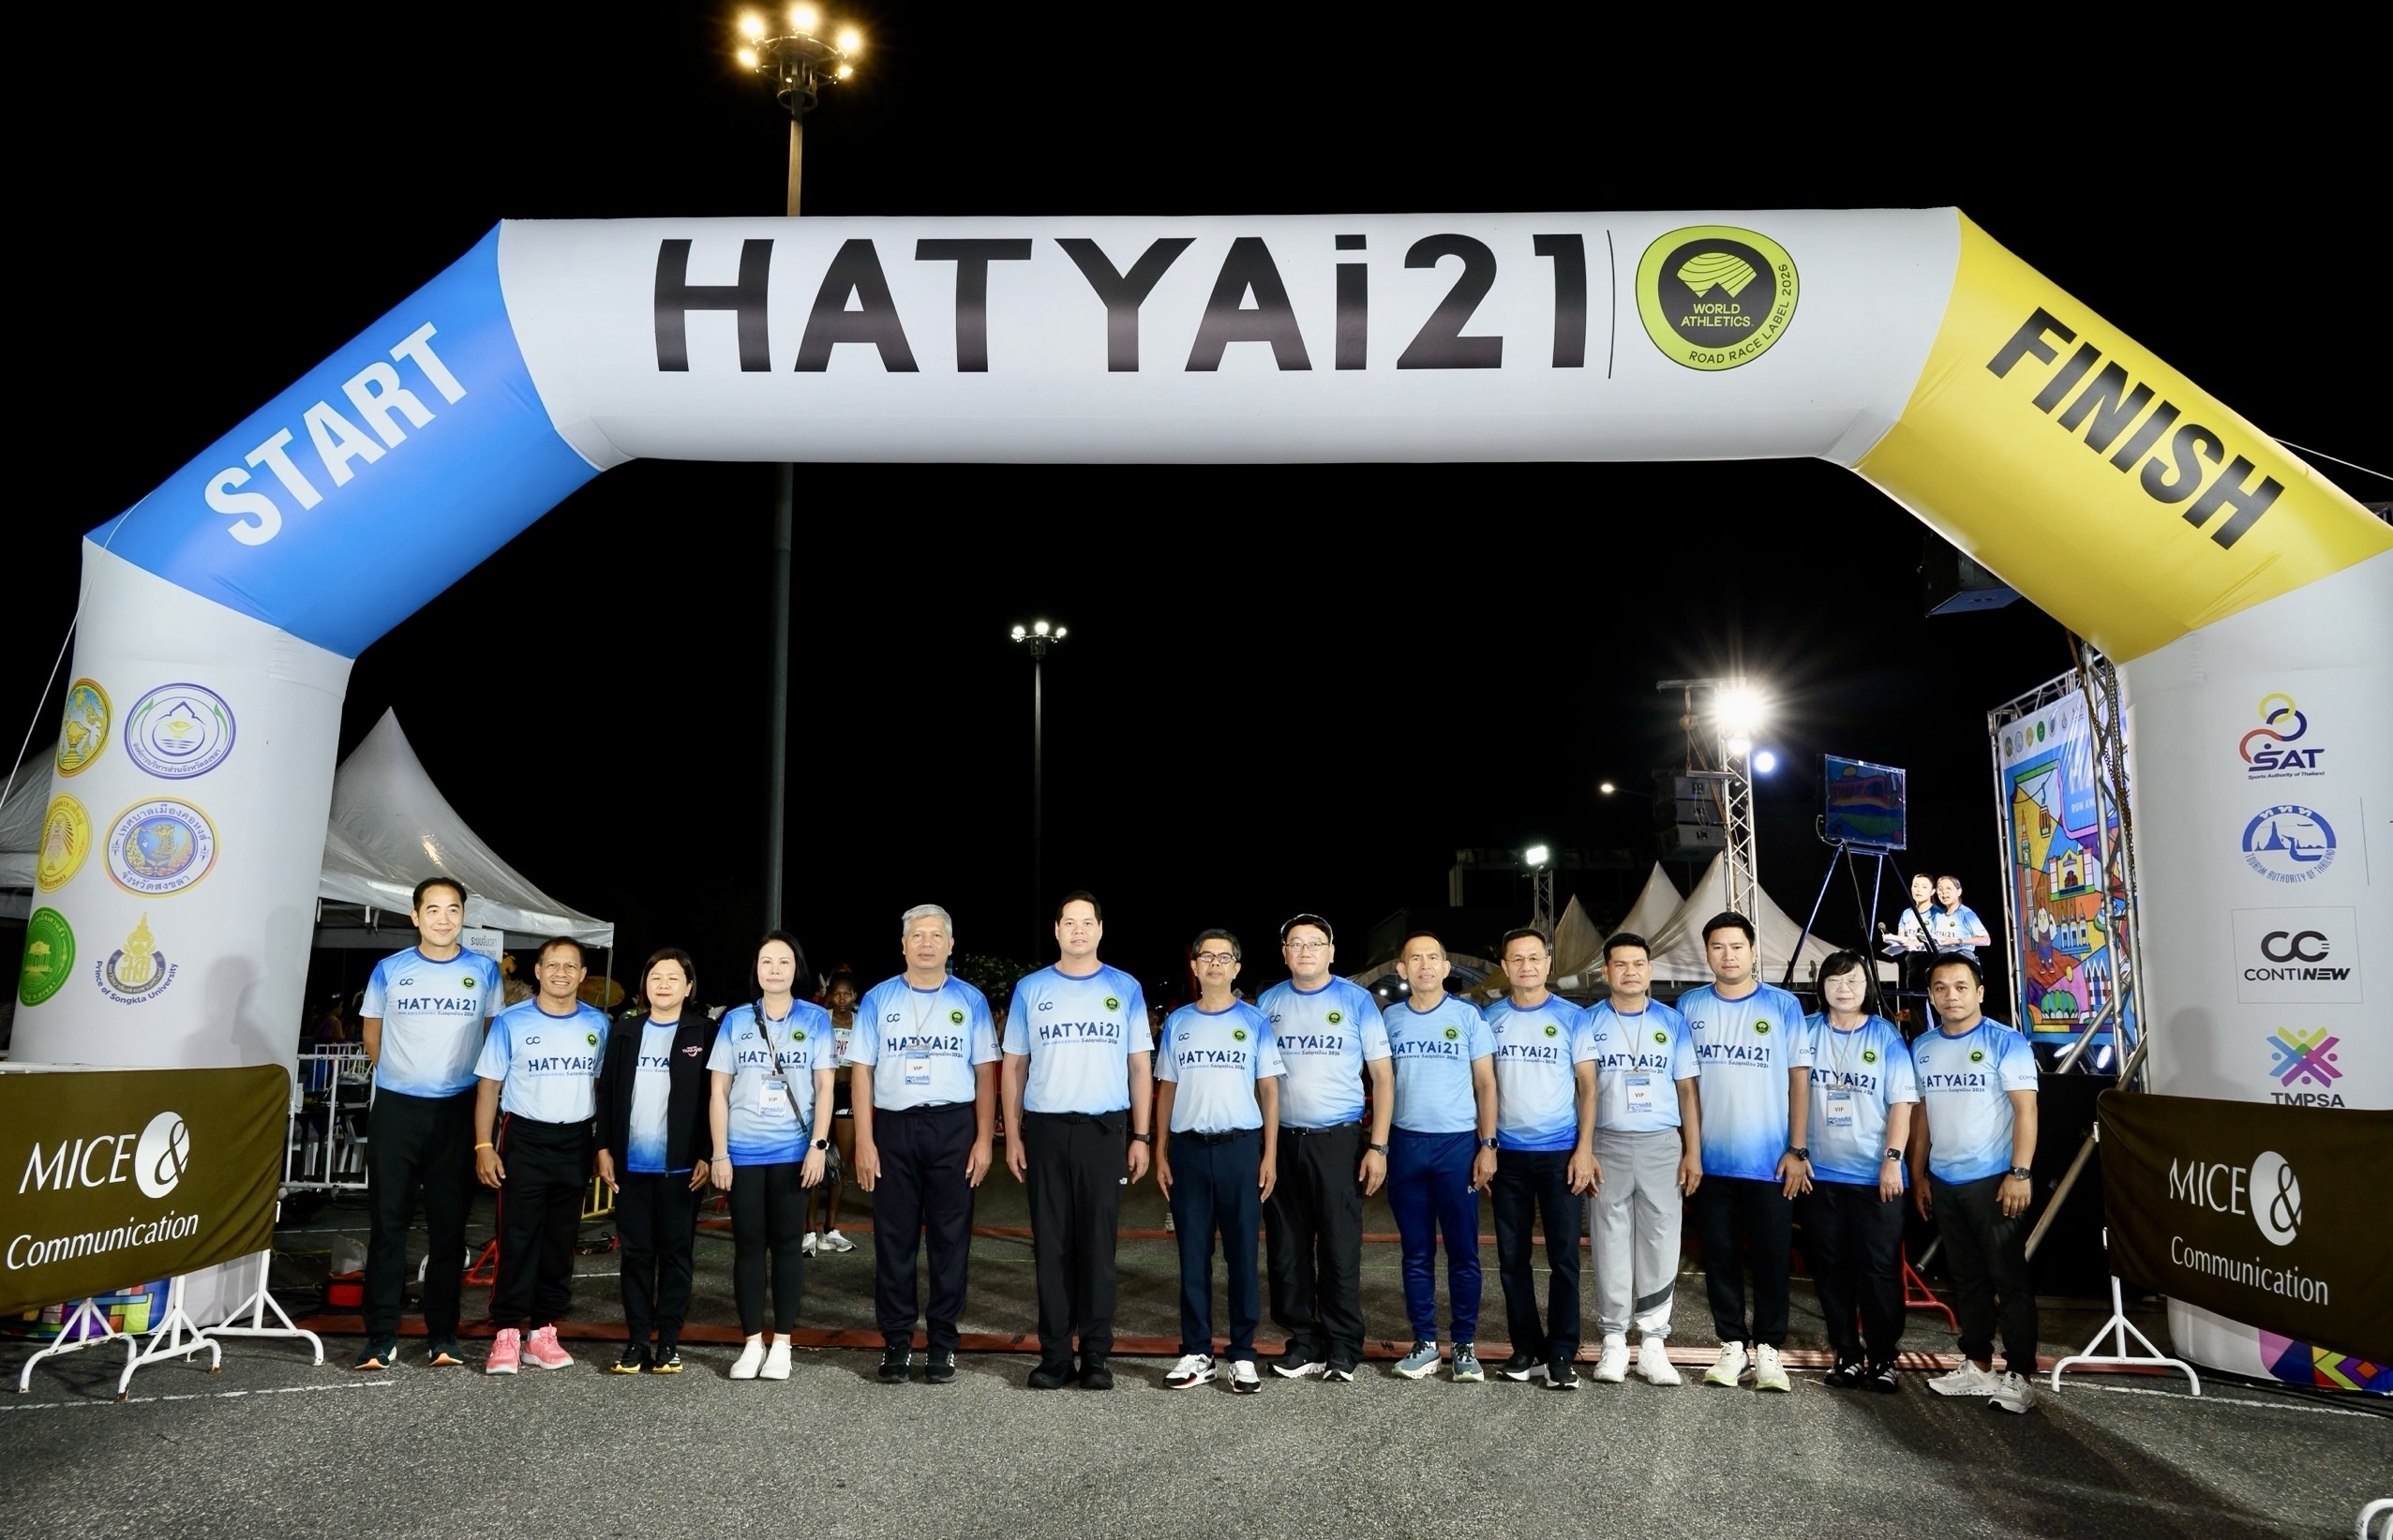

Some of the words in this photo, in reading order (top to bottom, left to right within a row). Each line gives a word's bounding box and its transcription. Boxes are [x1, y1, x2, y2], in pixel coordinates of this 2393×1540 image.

[653, 233, 1587, 372] HATYAi21
[1688, 351, 1725, 364] ROAD
[1728, 338, 1762, 362] RACE
[1762, 301, 1789, 340] LABEL
[1778, 263, 1792, 296] 2026
[1693, 304, 1740, 314] WORLD
[1681, 316, 1751, 327] ATHLETICS
[204, 321, 468, 546] START
[1985, 307, 2285, 551] FINISH
[2248, 747, 2326, 772] SAT
[2245, 853, 2267, 876] TOURISM
[2266, 870, 2306, 884] AUTHORITY
[2306, 869, 2315, 880] OF
[2314, 848, 2336, 875] THAILAND
[121, 869, 191, 890] จังหวัดสงขลา
[95, 960, 104, 987] Prince
[101, 986, 111, 995] of
[110, 993, 147, 1006] Songkla
[147, 963, 179, 999] University
[2244, 967, 2351, 981] CONTINEW
[397, 997, 477, 1011] HATYAi21
[1039, 1022, 1120, 1040] HATYAi21
[1276, 1035, 1343, 1050] ATYAi21
[739, 1051, 807, 1064] HATAi21
[1810, 1069, 1877, 1090] ATYAi21
[2270, 1091, 2346, 1108] TMPSA
[19, 1133, 137, 1194] MICE
[2168, 1157, 2247, 1216] MICE
[7, 1209, 199, 1270] Communication
[2171, 1235, 2329, 1306] Communication
